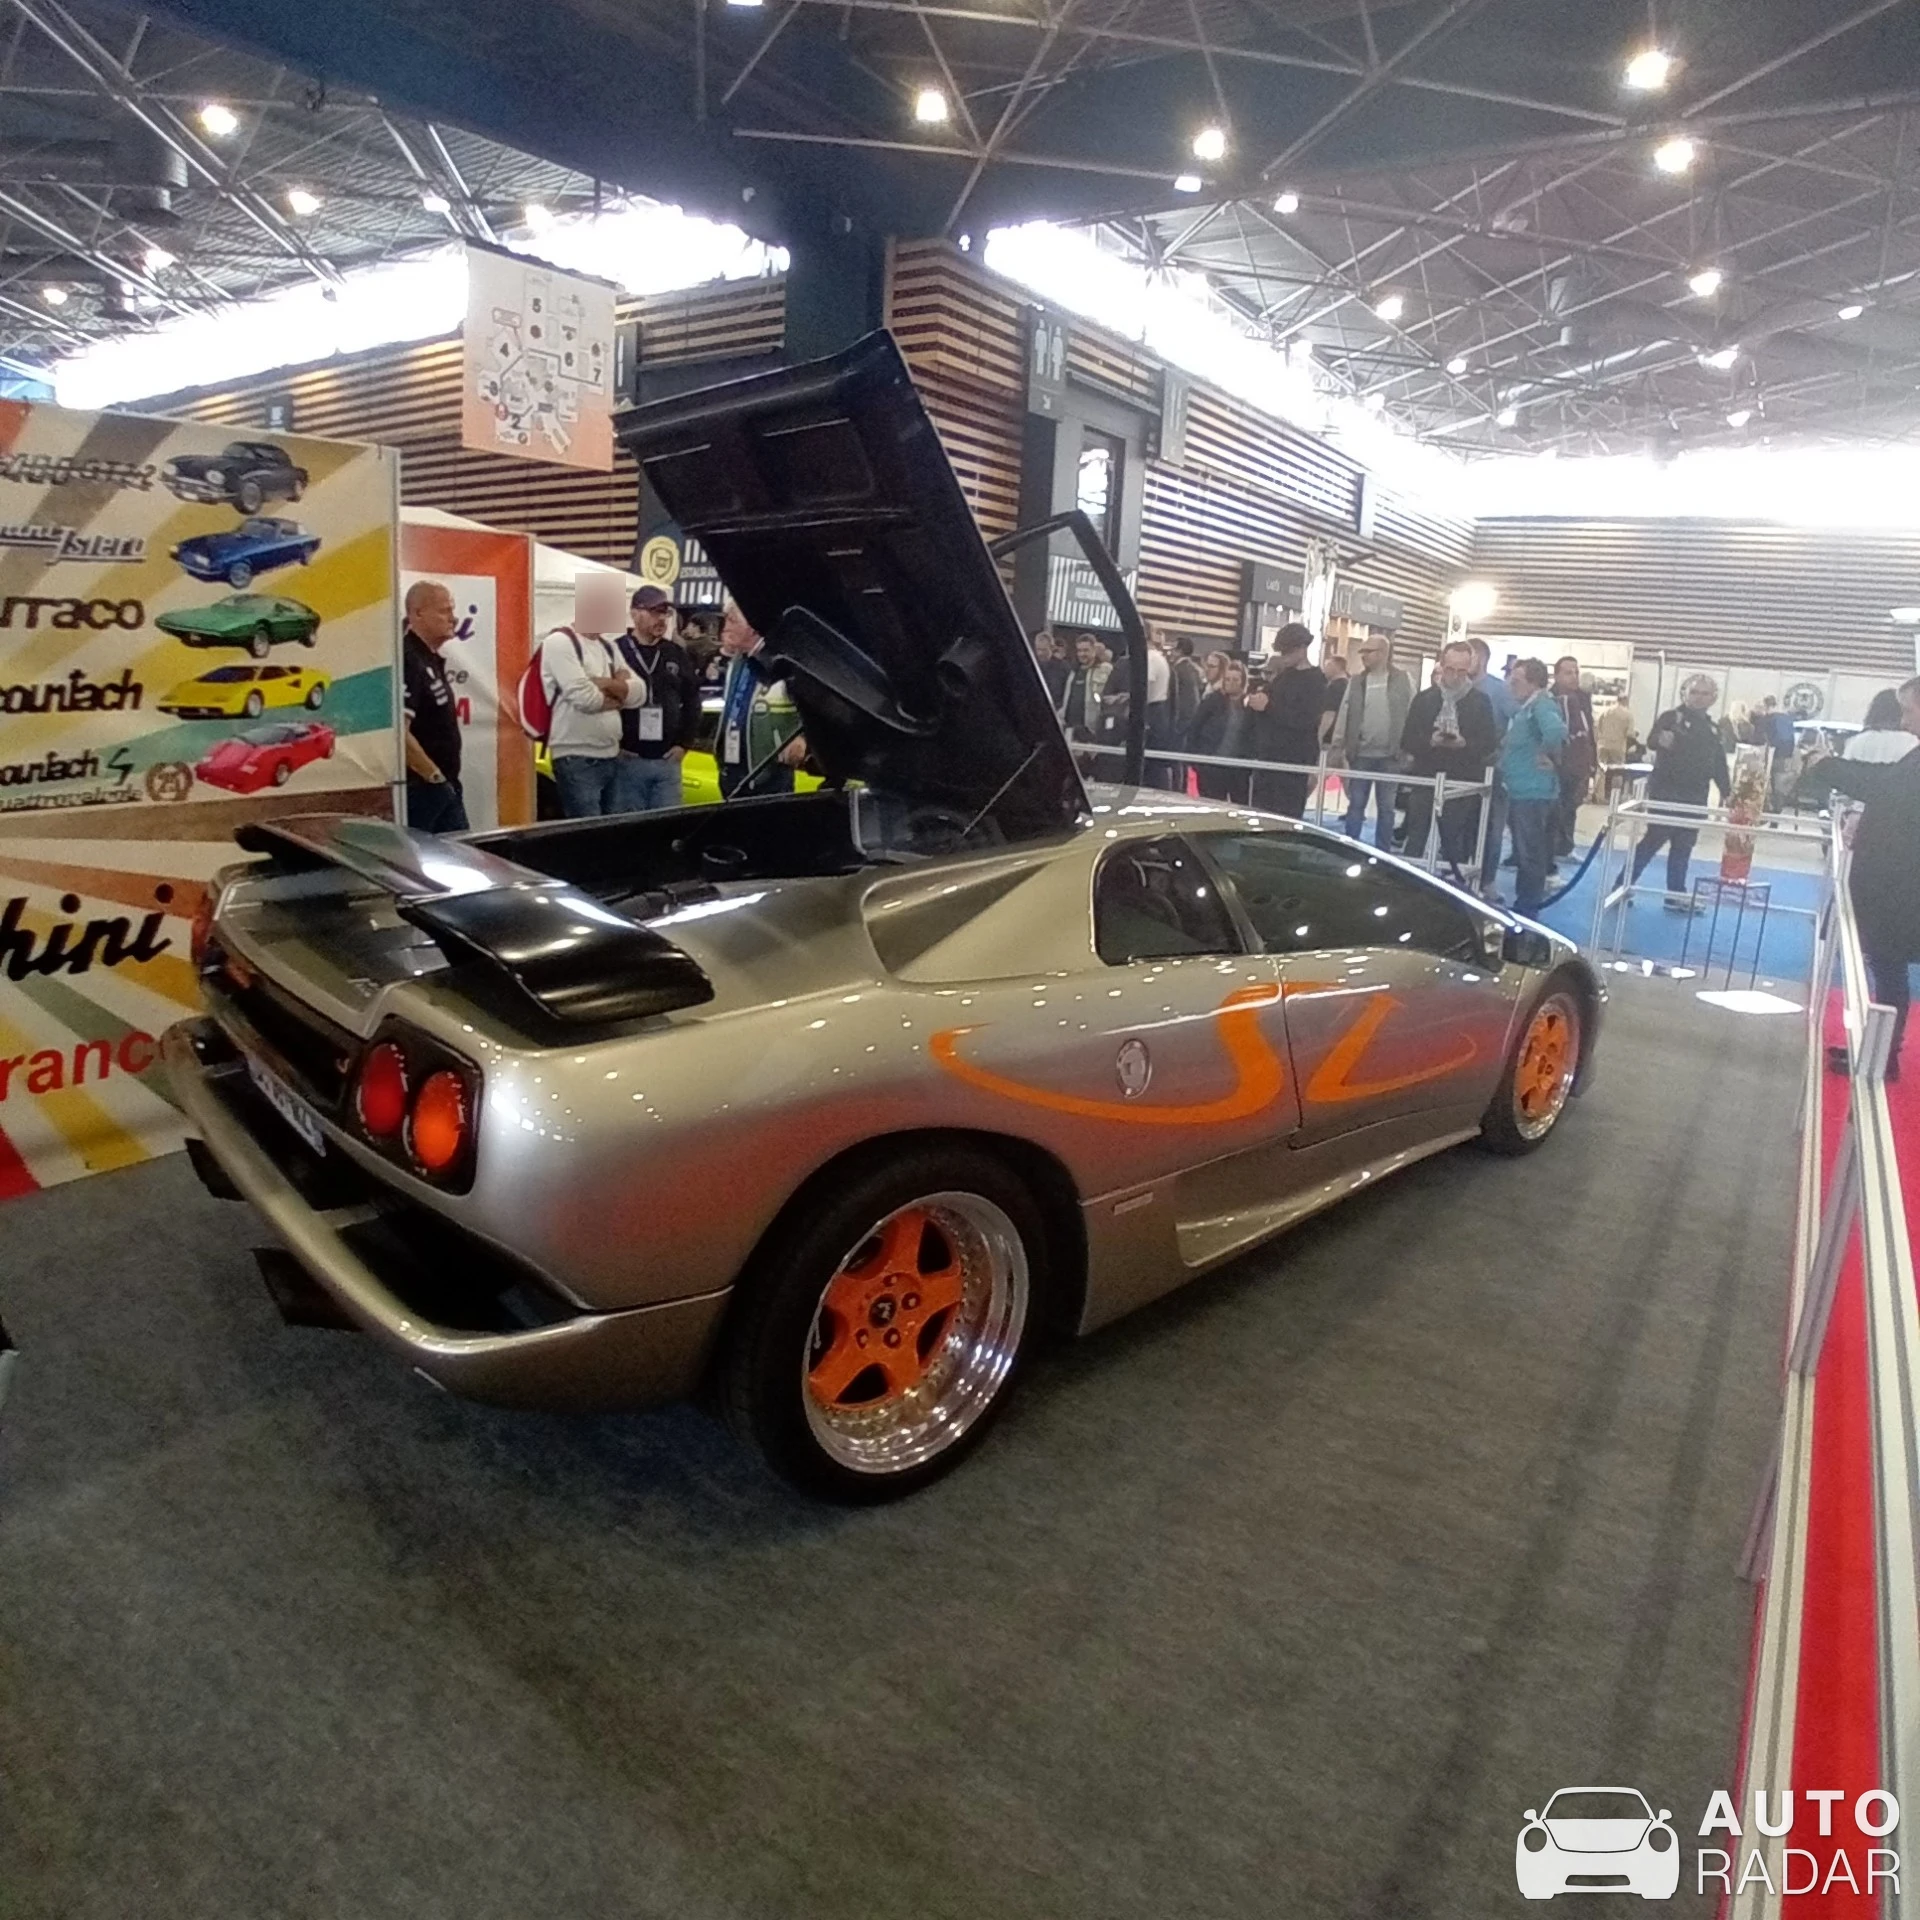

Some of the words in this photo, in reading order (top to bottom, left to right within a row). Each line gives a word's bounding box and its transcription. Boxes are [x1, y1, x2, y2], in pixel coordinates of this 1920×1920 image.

[0, 596, 145, 630] rraco
[0, 749, 99, 787] ountach
[0, 883, 172, 981] hini
[0, 1030, 160, 1102] ranc
